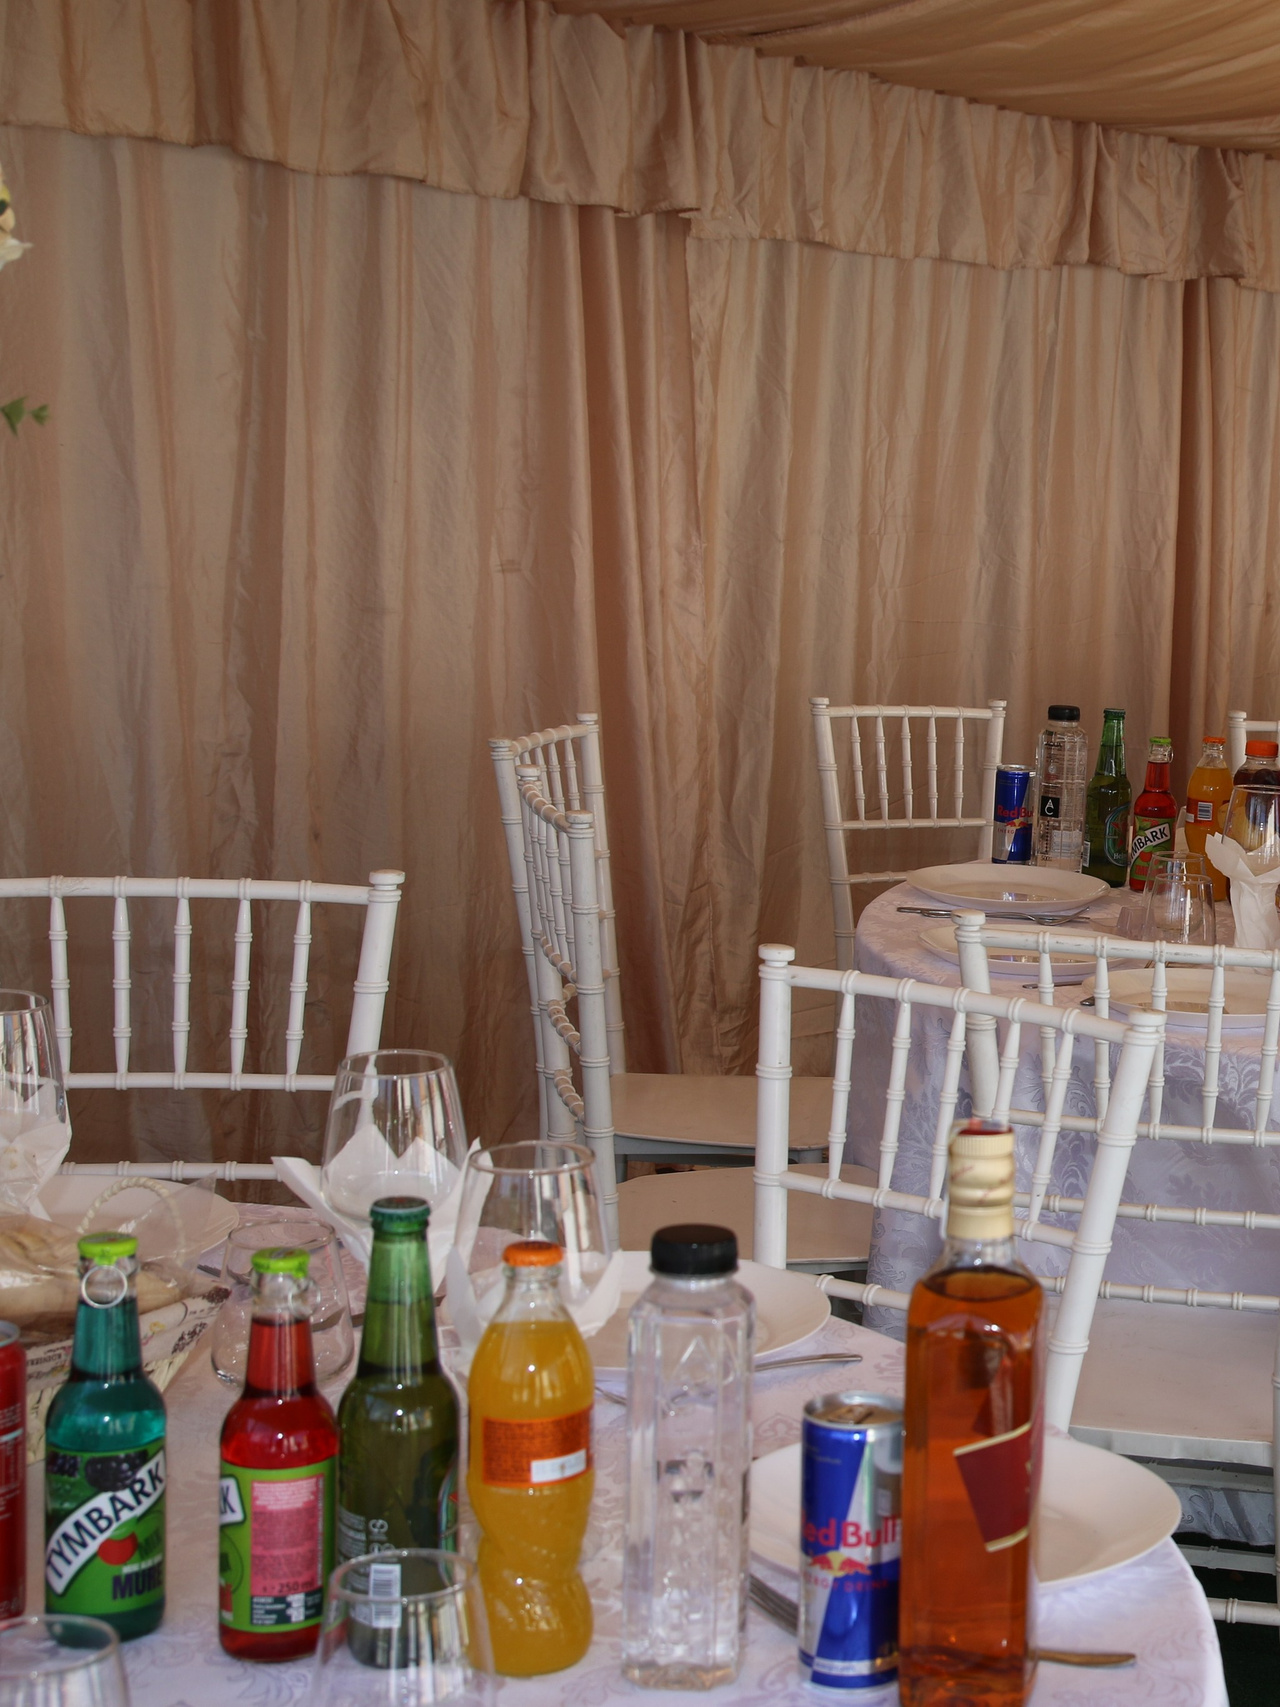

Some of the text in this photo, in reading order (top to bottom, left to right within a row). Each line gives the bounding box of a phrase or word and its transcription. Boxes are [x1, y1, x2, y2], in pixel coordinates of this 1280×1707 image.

[997, 804, 1019, 819] Red
[1131, 826, 1168, 858] MBARK
[46, 1460, 164, 1580] TYMBARK
[802, 1513, 897, 1549] ed Bull
